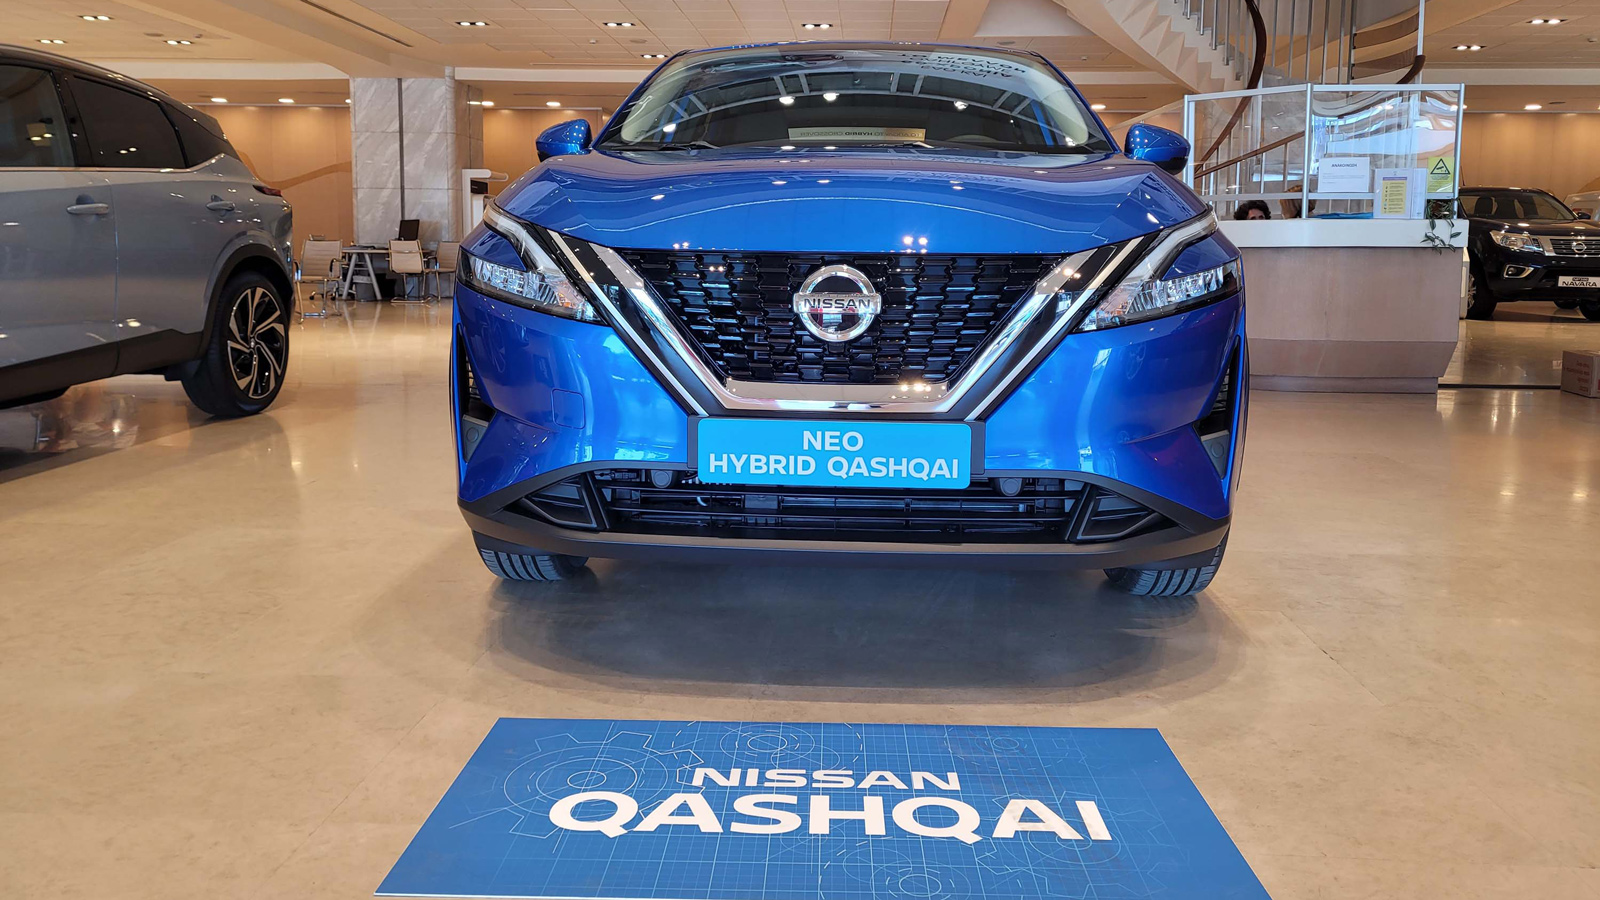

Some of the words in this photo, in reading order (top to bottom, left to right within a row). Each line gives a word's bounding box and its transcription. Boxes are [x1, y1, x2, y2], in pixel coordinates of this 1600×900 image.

[803, 298, 871, 309] NISSAN
[709, 453, 816, 475] HYBRID
[827, 456, 959, 481] QASHQAI
[691, 767, 962, 791] NISSAN
[548, 790, 1113, 845] QASHQAI
